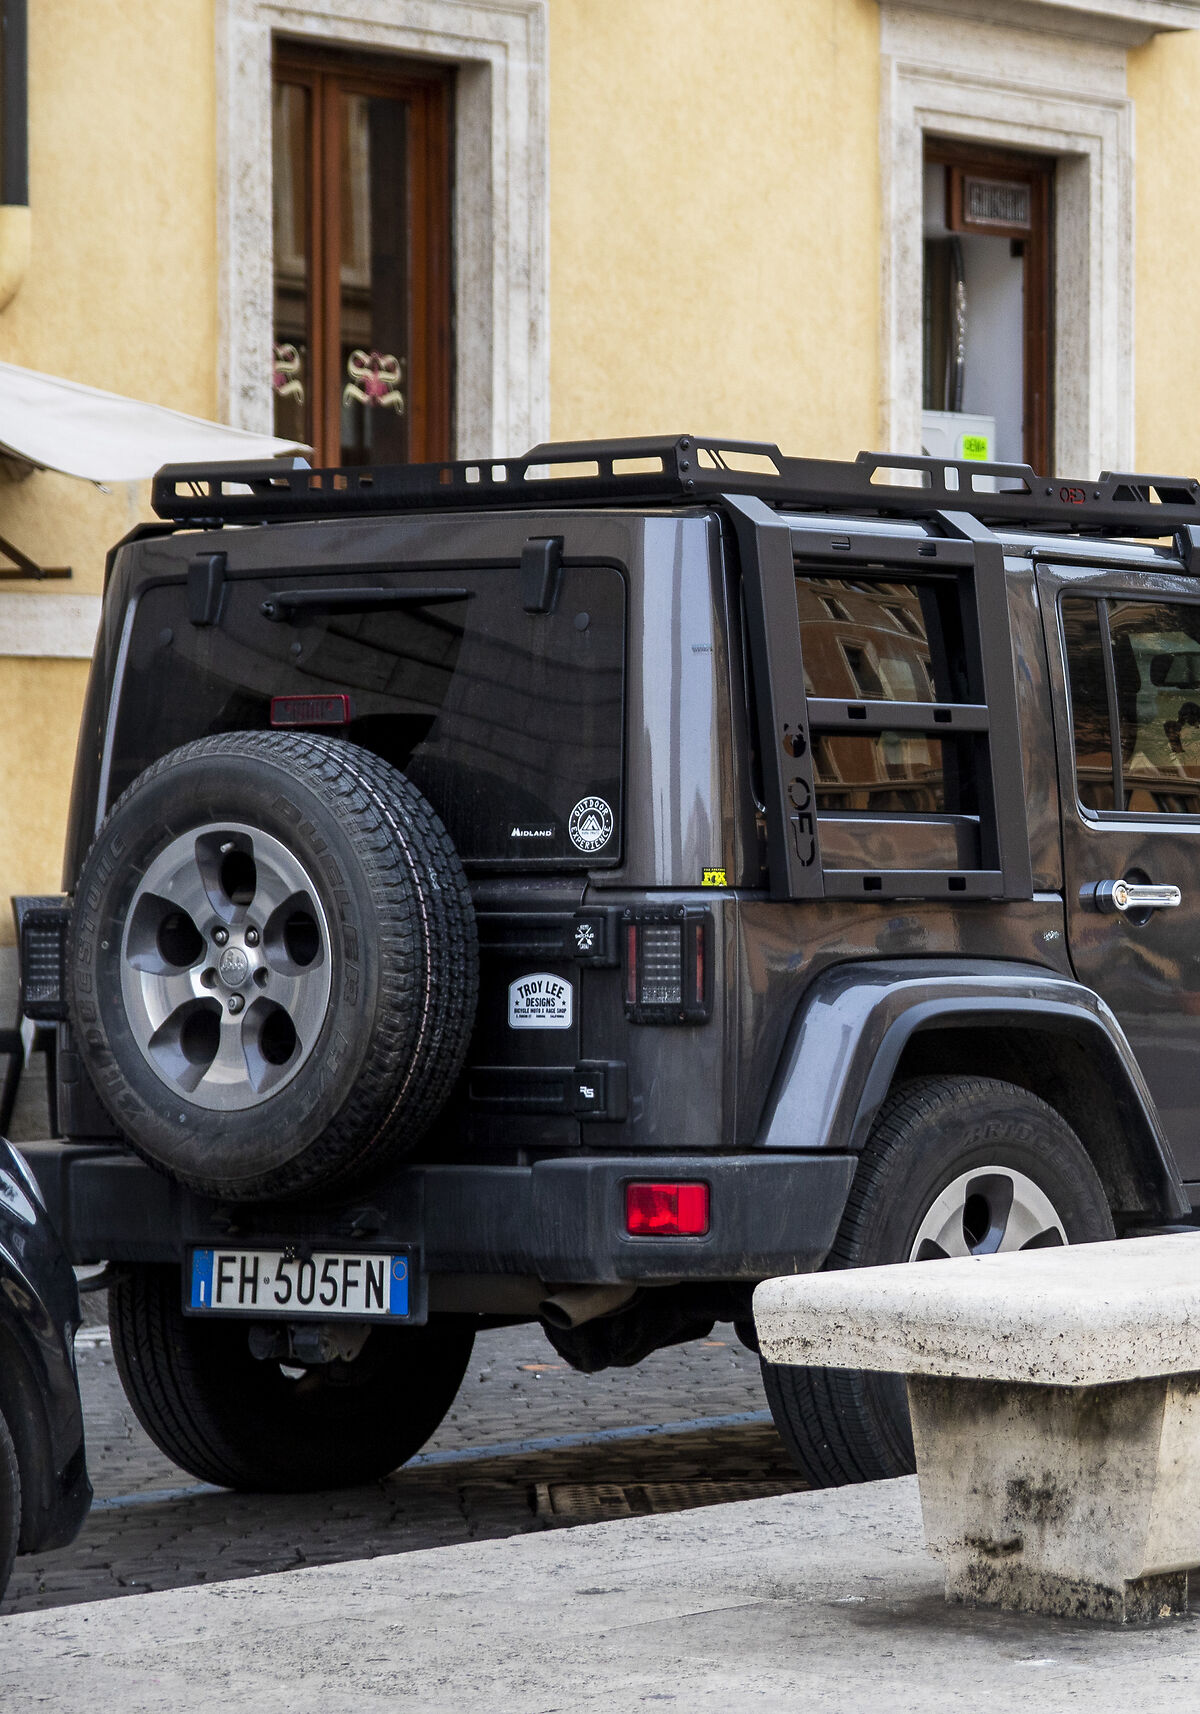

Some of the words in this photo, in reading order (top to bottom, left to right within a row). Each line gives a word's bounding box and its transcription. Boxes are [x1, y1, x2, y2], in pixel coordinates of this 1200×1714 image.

[574, 799, 609, 817] OUTDOOR
[511, 827, 552, 837] MIDLAND
[570, 825, 611, 850] EXPERIENCE
[704, 871, 726, 886] FOX
[516, 980, 543, 999] TROY
[545, 980, 565, 999] LEE
[525, 997, 556, 1007] DESIGNS
